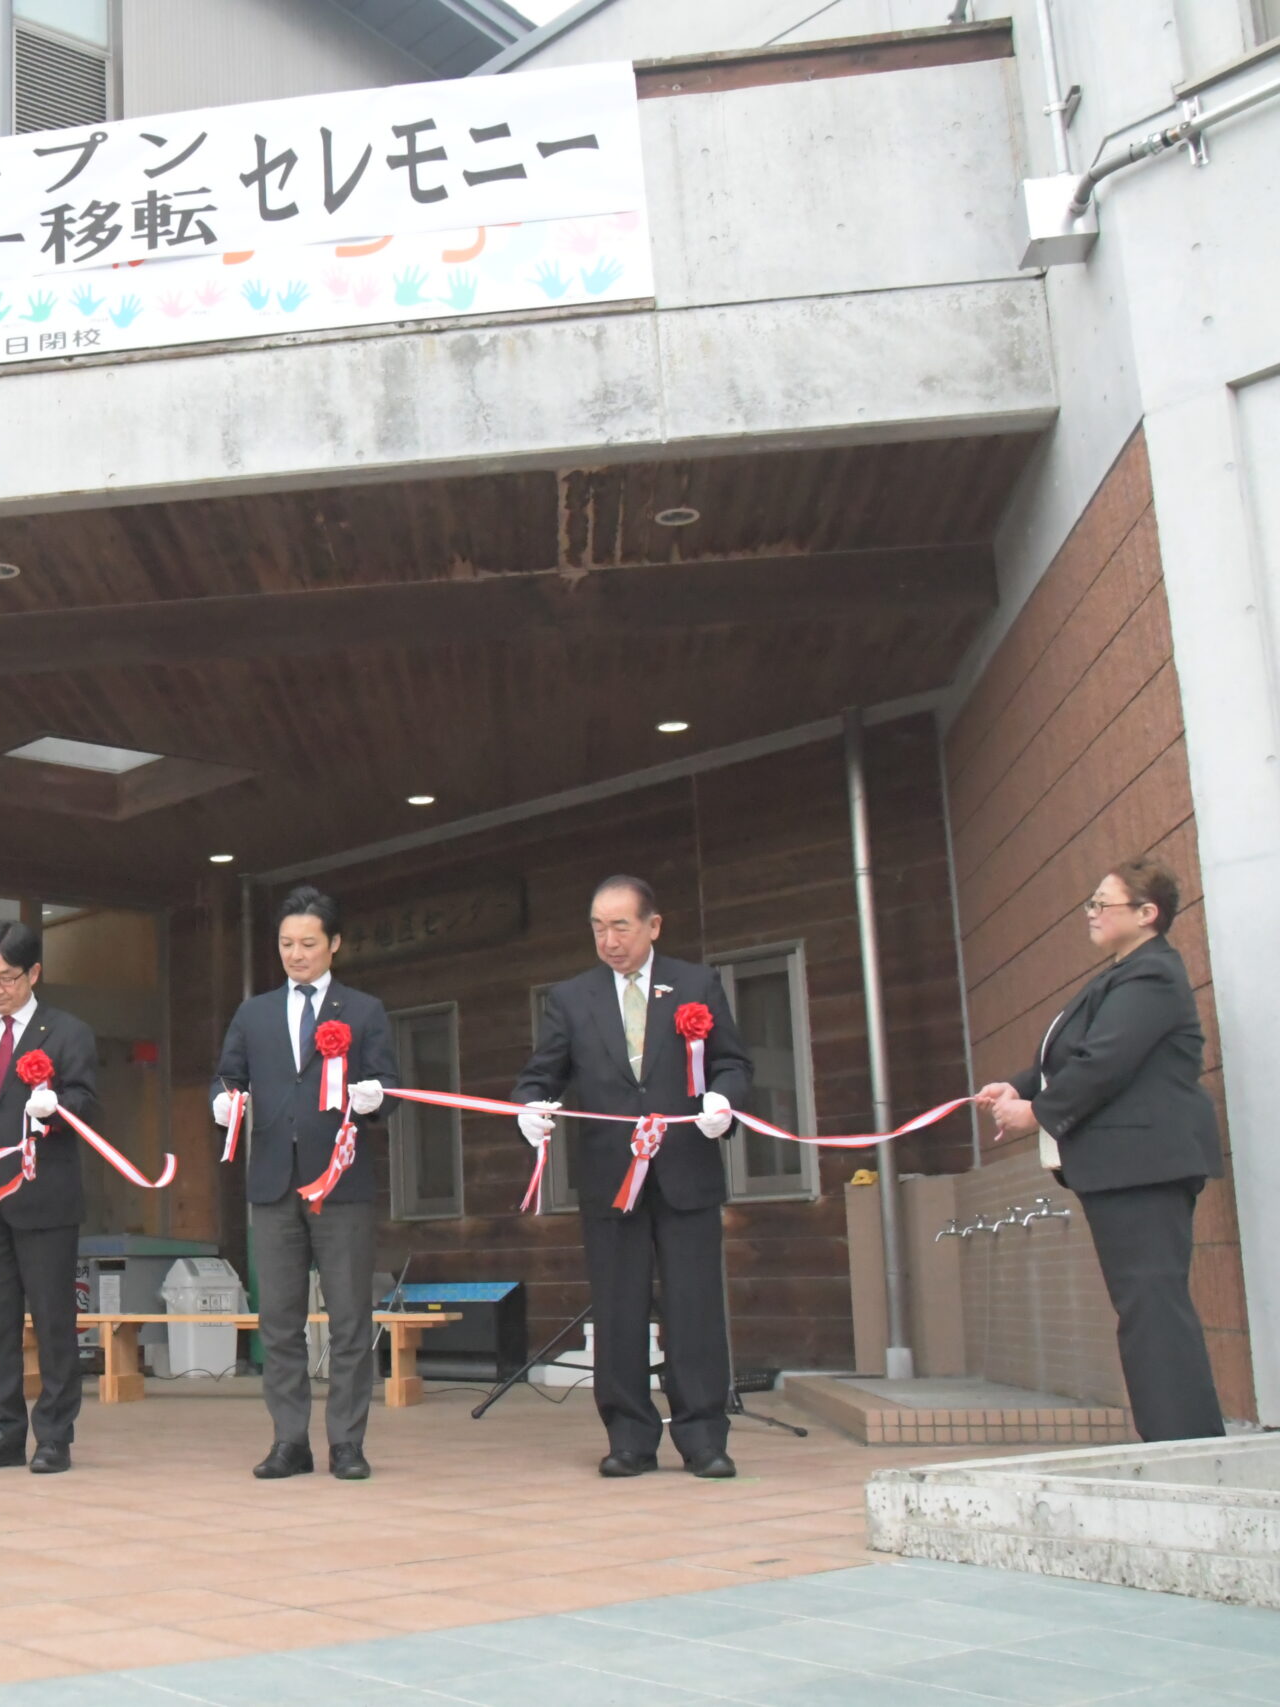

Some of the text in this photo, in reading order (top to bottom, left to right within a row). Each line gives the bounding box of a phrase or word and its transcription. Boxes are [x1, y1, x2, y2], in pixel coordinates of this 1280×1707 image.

[239, 117, 600, 222] セレモニー
